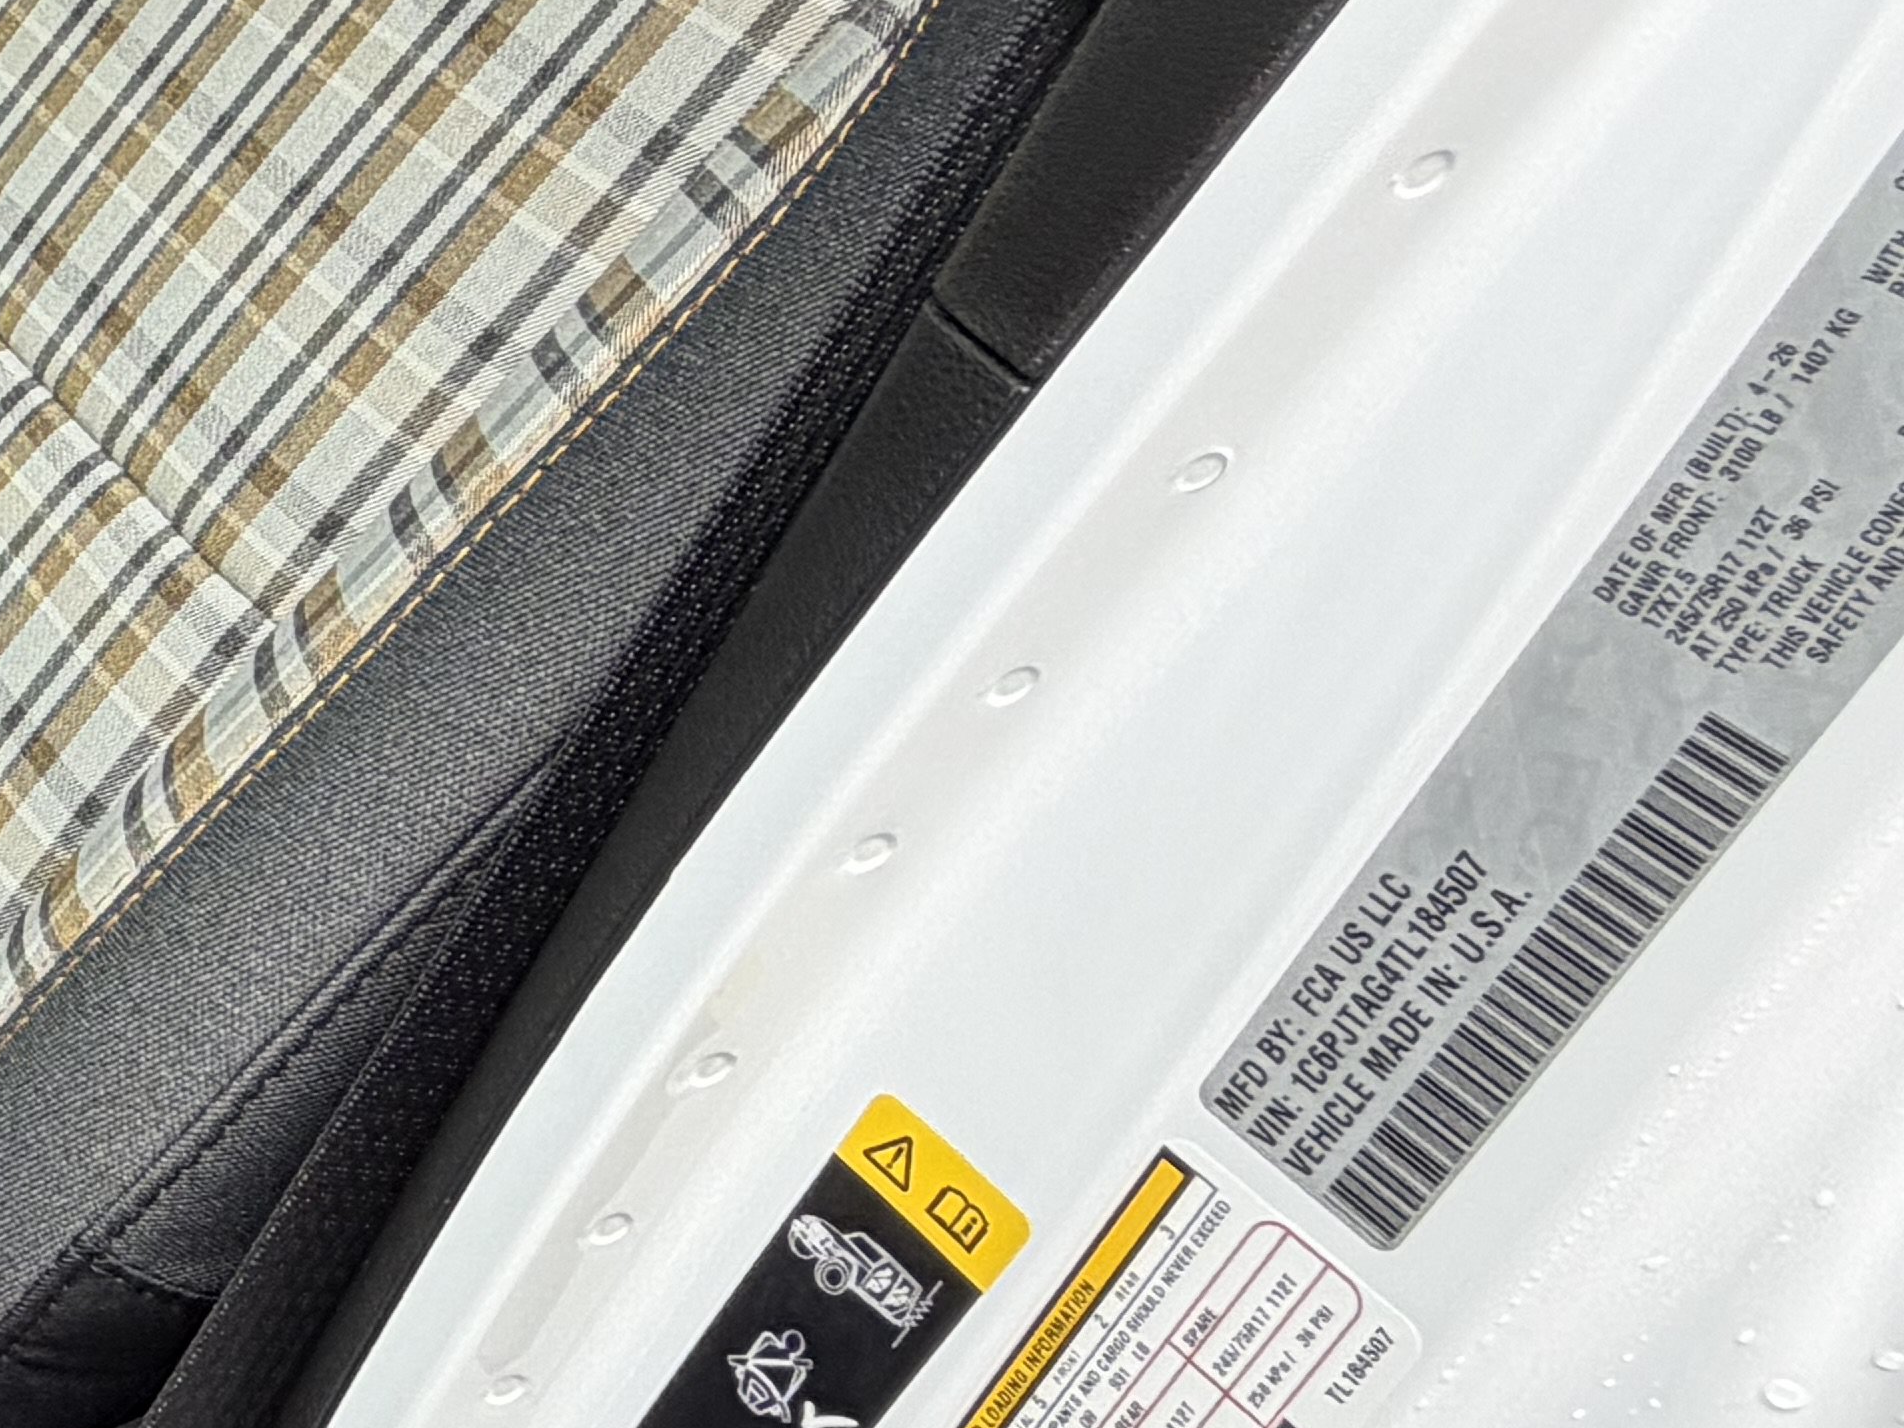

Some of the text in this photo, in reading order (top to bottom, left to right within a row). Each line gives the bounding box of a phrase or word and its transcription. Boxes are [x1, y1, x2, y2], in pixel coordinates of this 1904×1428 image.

[1592, 551, 1642, 604] DATE
[1629, 524, 1658, 553] OF
[1650, 482, 1695, 525] MFR
[1684, 406, 1753, 482] (BUILT):
[1617, 560, 1672, 617] GAWR
[1659, 491, 1725, 560] FRONT:
[1718, 436, 1765, 483] 3100
[1750, 408, 1785, 436] LB
[1791, 338, 1835, 384] 1407
[1824, 308, 1862, 339] KG
[1641, 568, 1698, 629] 17X7.5
[1664, 505, 1780, 646] 245/75R17 112T
[1689, 630, 1721, 662] AT
[1710, 596, 1749, 632] 250
[1735, 562, 1778, 598] kPa
[1780, 514, 1813, 541] 36
[1799, 478, 1841, 514] PSI
[1712, 554, 1824, 674] TYPE: TRUCK
[1759, 482, 1904, 670] THIS VEHICLE CONF
[1805, 546, 1904, 664] SAFETY AND
[1213, 872, 1412, 1121] MFD BY: FCA US LLC
[1246, 849, 1487, 1147] VIN: 1C6PJTAG4TL184507
[1281, 889, 1533, 1176] VEHICLE MADE IN: U.S.A.
[980, 1368, 1028, 1428] LOADING
[1022, 1279, 1096, 1372] INFORMATION
[1032, 1394, 1048, 1410] 5
[1093, 1313, 1110, 1330] 2
[1159, 1224, 1176, 1241] 3
[1078, 1369, 1101, 1397] AND
[1096, 1330, 1131, 1372] CARGO
[1125, 1285, 1166, 1333] SHOULD
[1160, 1245, 1197, 1288] NEVER
[1190, 1200, 1232, 1249] EXCEED
[1108, 1366, 1131, 1392] 931
[1182, 1307, 1218, 1348] SPARE
[1324, 1326, 1394, 1405] TL184507
